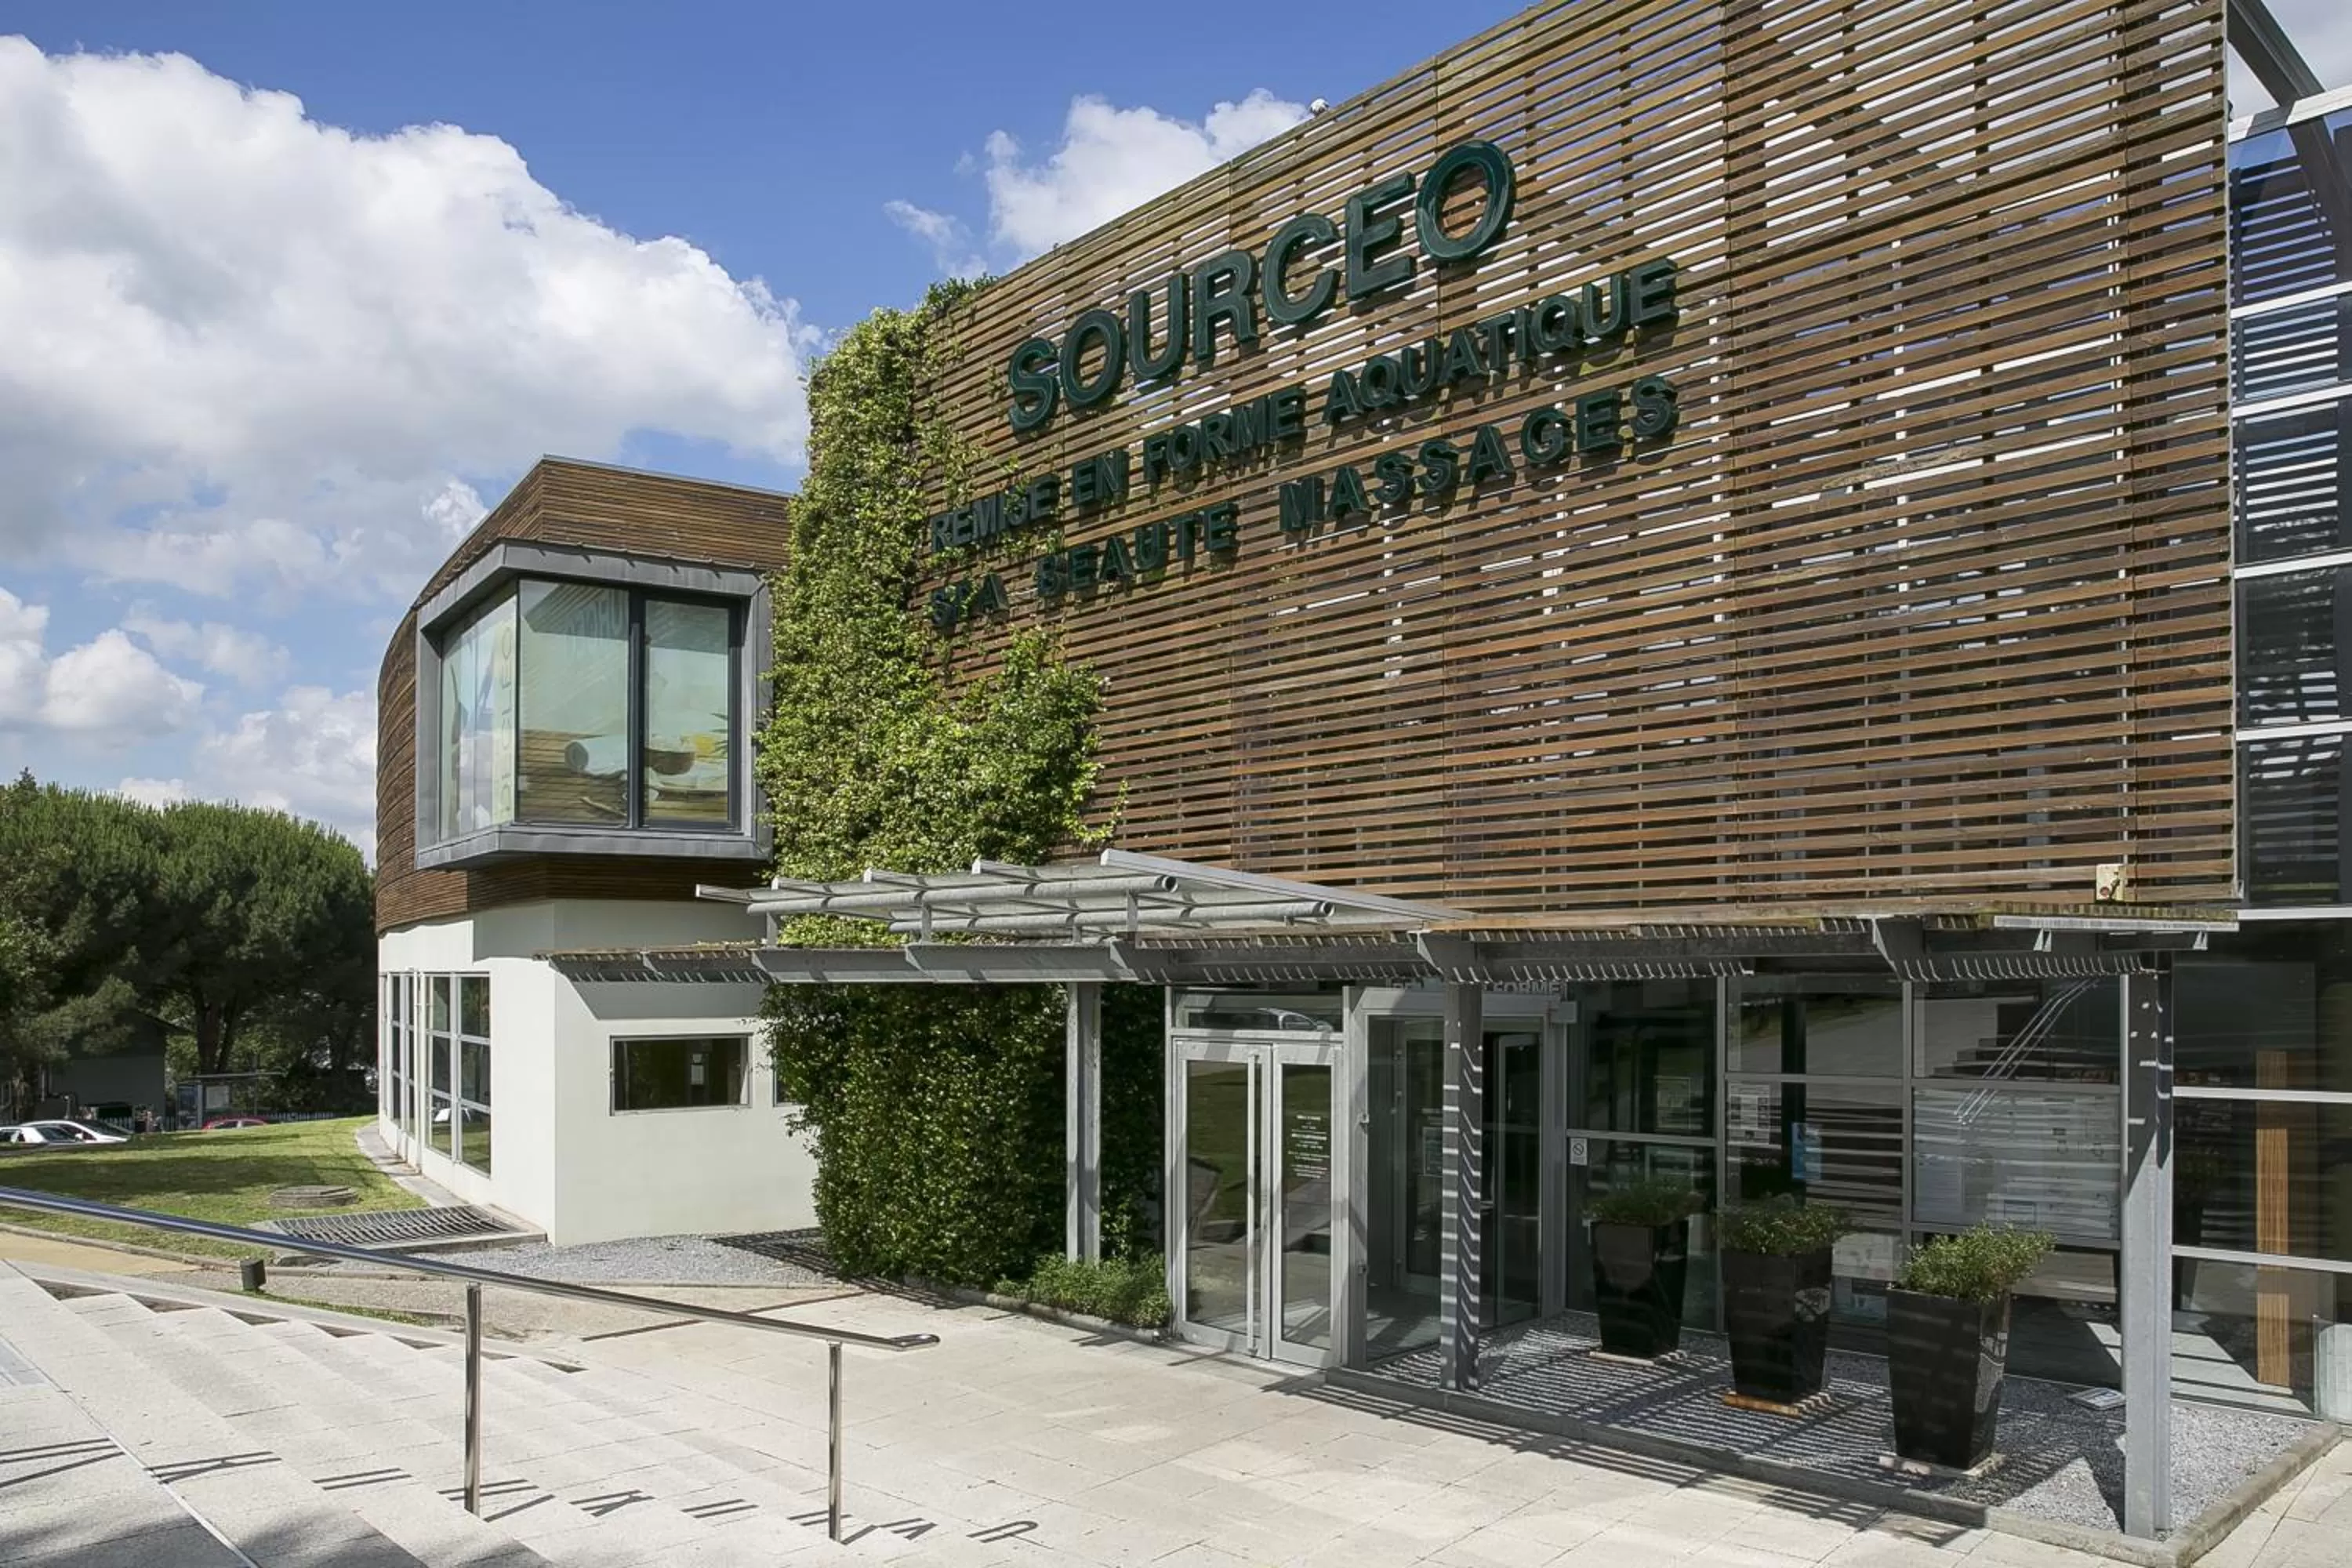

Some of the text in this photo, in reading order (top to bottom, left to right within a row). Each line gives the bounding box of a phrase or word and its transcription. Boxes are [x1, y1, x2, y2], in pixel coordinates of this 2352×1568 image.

[931, 258, 1679, 551] REMISE EN FORME AQUATIQUE
[1009, 139, 1516, 433] SOURCEO
[1036, 501, 1240, 598] BEAUTE
[1279, 375, 1680, 534] MASSAGES
